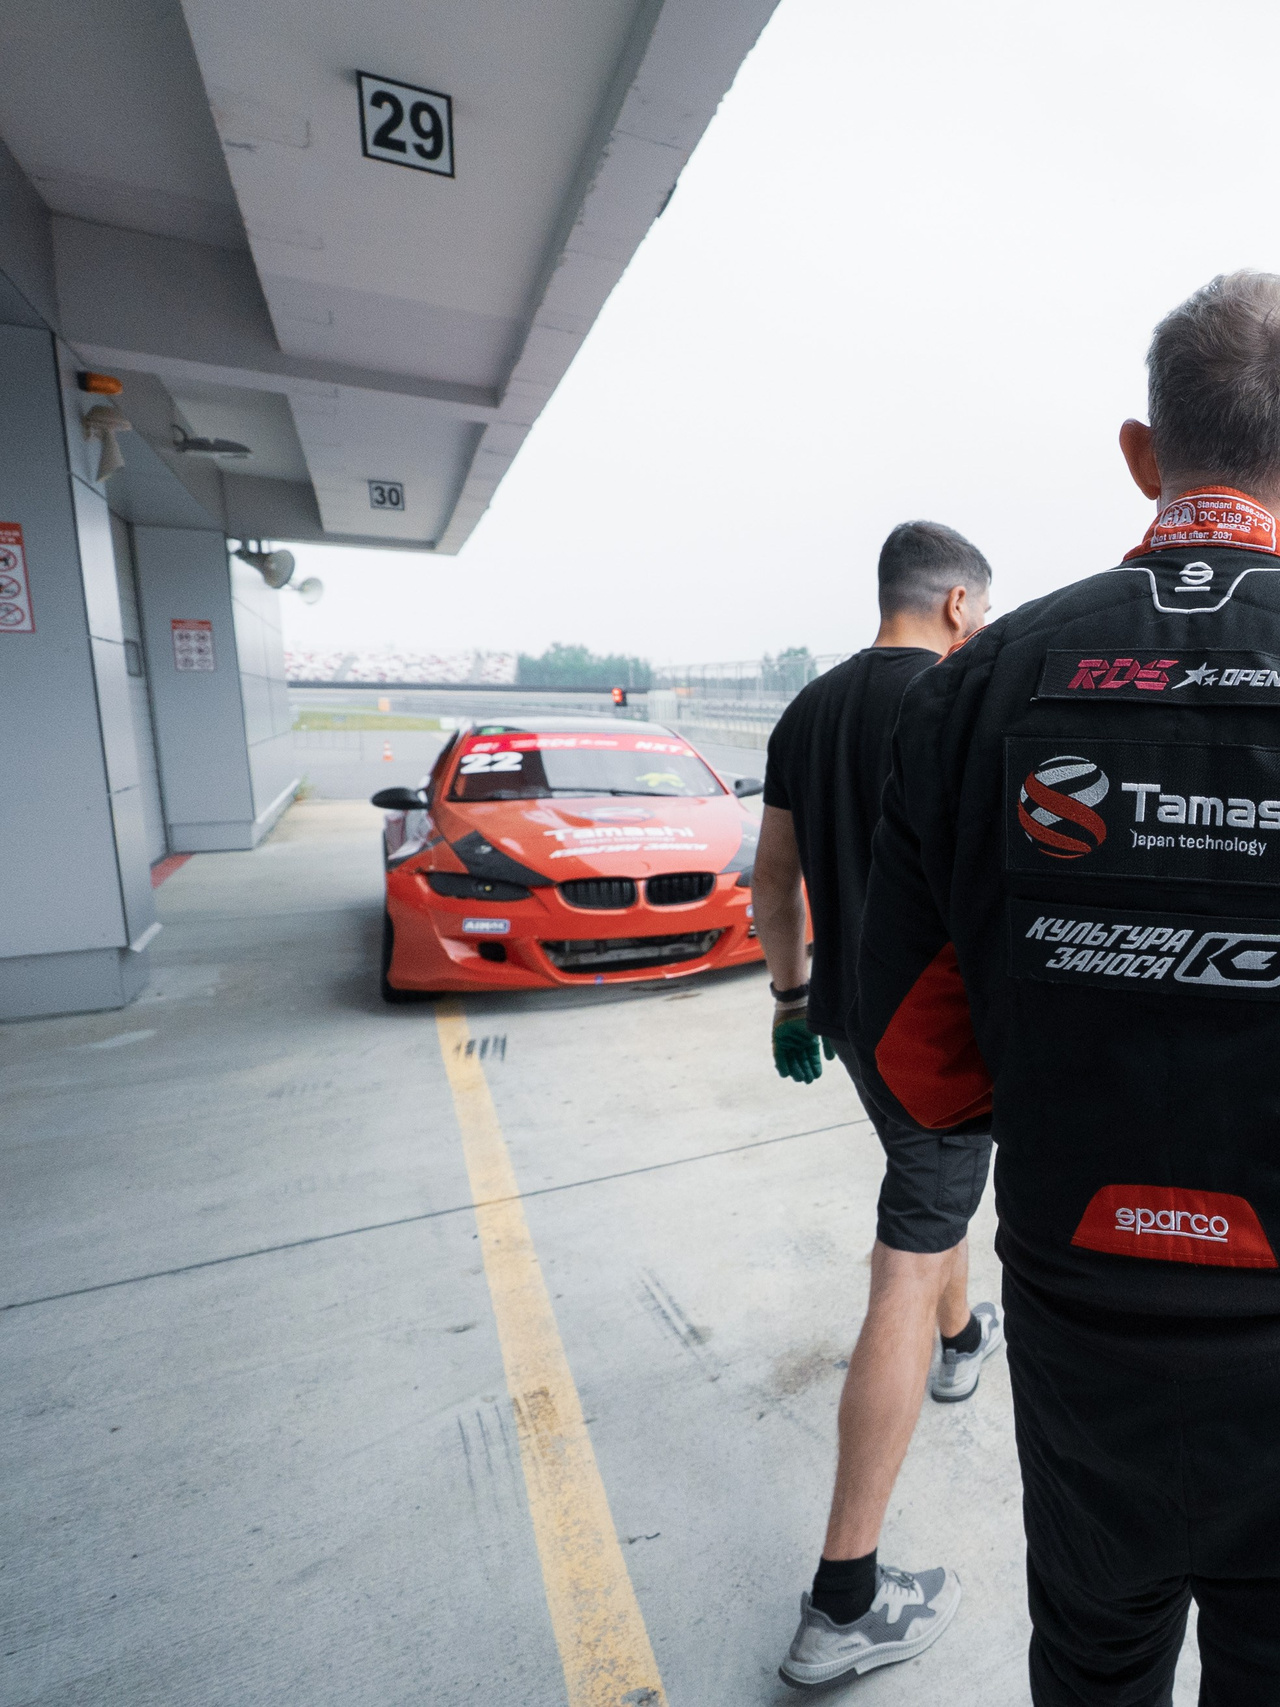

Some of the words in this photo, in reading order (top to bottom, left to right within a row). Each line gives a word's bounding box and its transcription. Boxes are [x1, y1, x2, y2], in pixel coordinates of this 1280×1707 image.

[370, 89, 443, 160] 29
[374, 485, 400, 506] 30
[1197, 500, 1232, 510] Standard
[1168, 531, 1187, 541] valid
[1211, 530, 1233, 541] 2031
[459, 751, 524, 775] 22
[1130, 829, 1175, 850] Japan
[1179, 832, 1267, 857] technology
[1026, 916, 1195, 954] КУЛЬТУРА
[1046, 946, 1176, 980] ЗАНОСА
[1115, 1206, 1230, 1242] sparco
